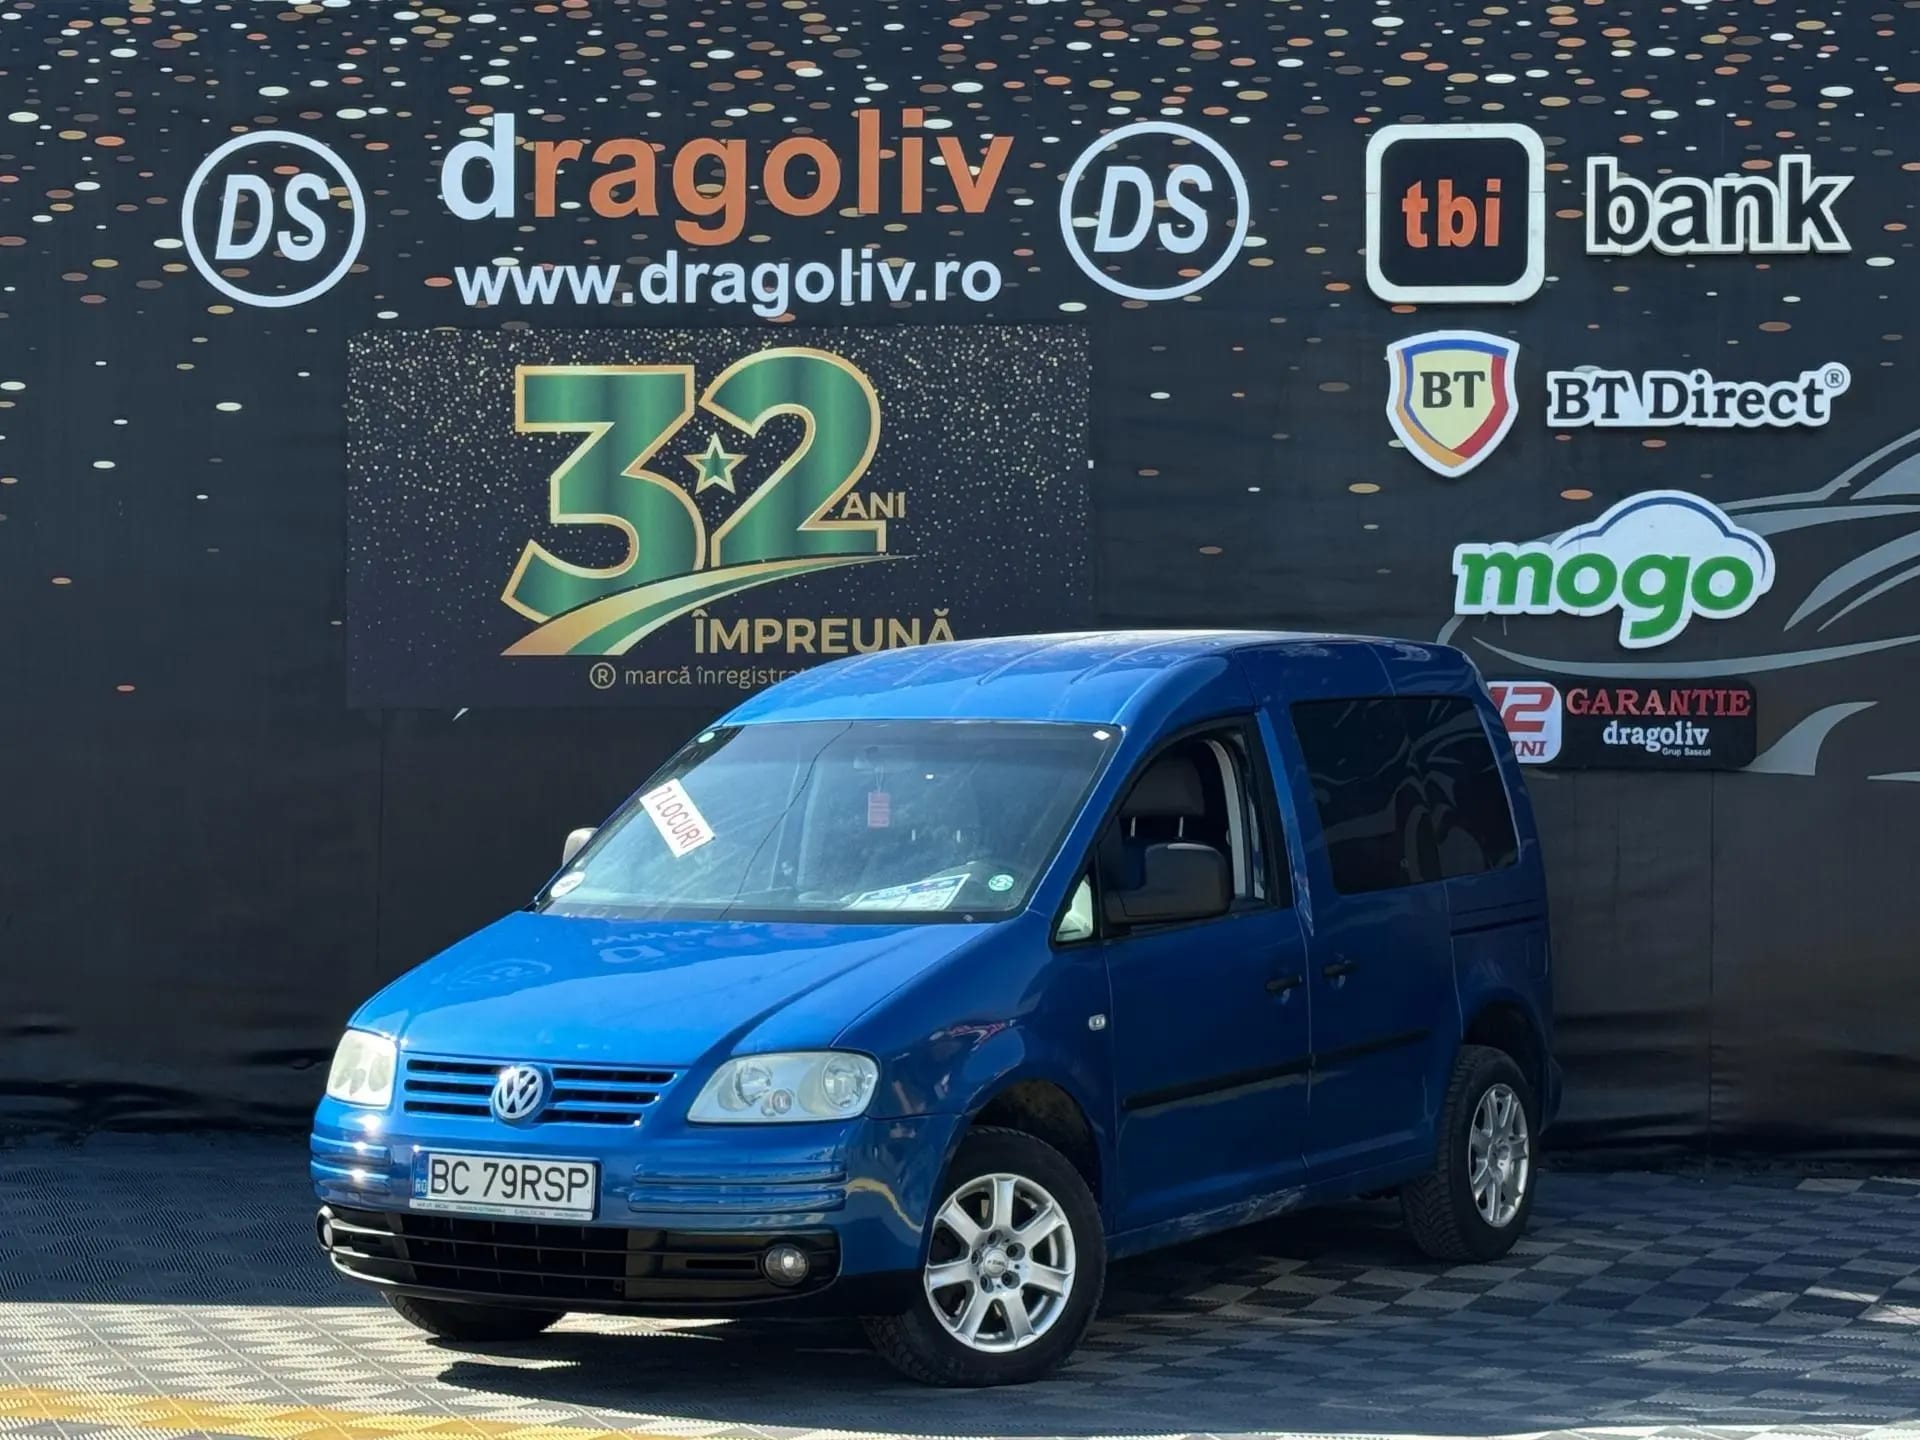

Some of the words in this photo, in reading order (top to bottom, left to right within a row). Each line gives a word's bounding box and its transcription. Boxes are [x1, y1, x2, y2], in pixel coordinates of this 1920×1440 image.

[440, 109, 1014, 246] dragoliv
[215, 173, 331, 261] DS
[1094, 163, 1213, 254] DS
[1402, 179, 1501, 248] tbi
[1589, 157, 1850, 251] bank
[454, 248, 1002, 318] www.dragoliv.ro
[1420, 371, 1485, 409] BT
[1553, 376, 1631, 419] BT
[501, 347, 887, 624] 32
[841, 492, 906, 519] ANI
[1461, 552, 1754, 640] mogo
[690, 608, 956, 654] ÎMPREUNĂ
[625, 665, 692, 686] marcă
[696, 664, 808, 690] înregistr
[1566, 688, 1751, 717] GARANTIE
[1602, 721, 1709, 753] dragoliv
[1662, 747, 1682, 758] Grup
[656, 794, 705, 849] LOCURI
[431, 1159, 471, 1195] BC
[483, 1162, 590, 1203] 79RSP
